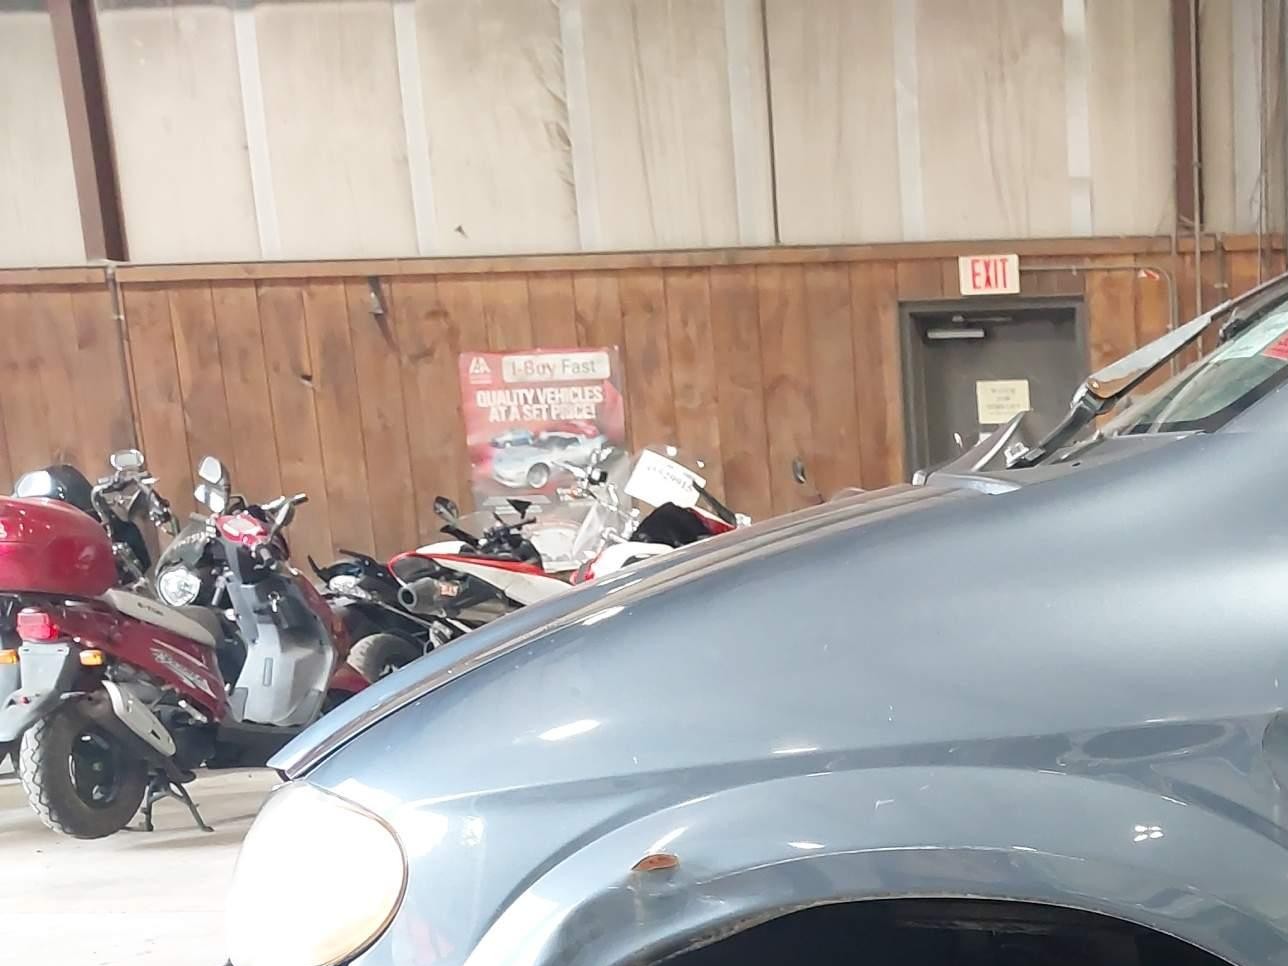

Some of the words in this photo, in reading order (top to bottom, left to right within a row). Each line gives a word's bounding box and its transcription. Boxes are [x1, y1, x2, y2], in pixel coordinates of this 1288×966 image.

[971, 258, 1009, 290] EXIT
[511, 359, 556, 378] I-Buy
[562, 358, 597, 374] Fast
[476, 388, 535, 408] QUALITY
[536, 386, 604, 404] VEHICLES
[489, 407, 509, 423] AT
[509, 407, 521, 421] A
[522, 405, 549, 421] SET
